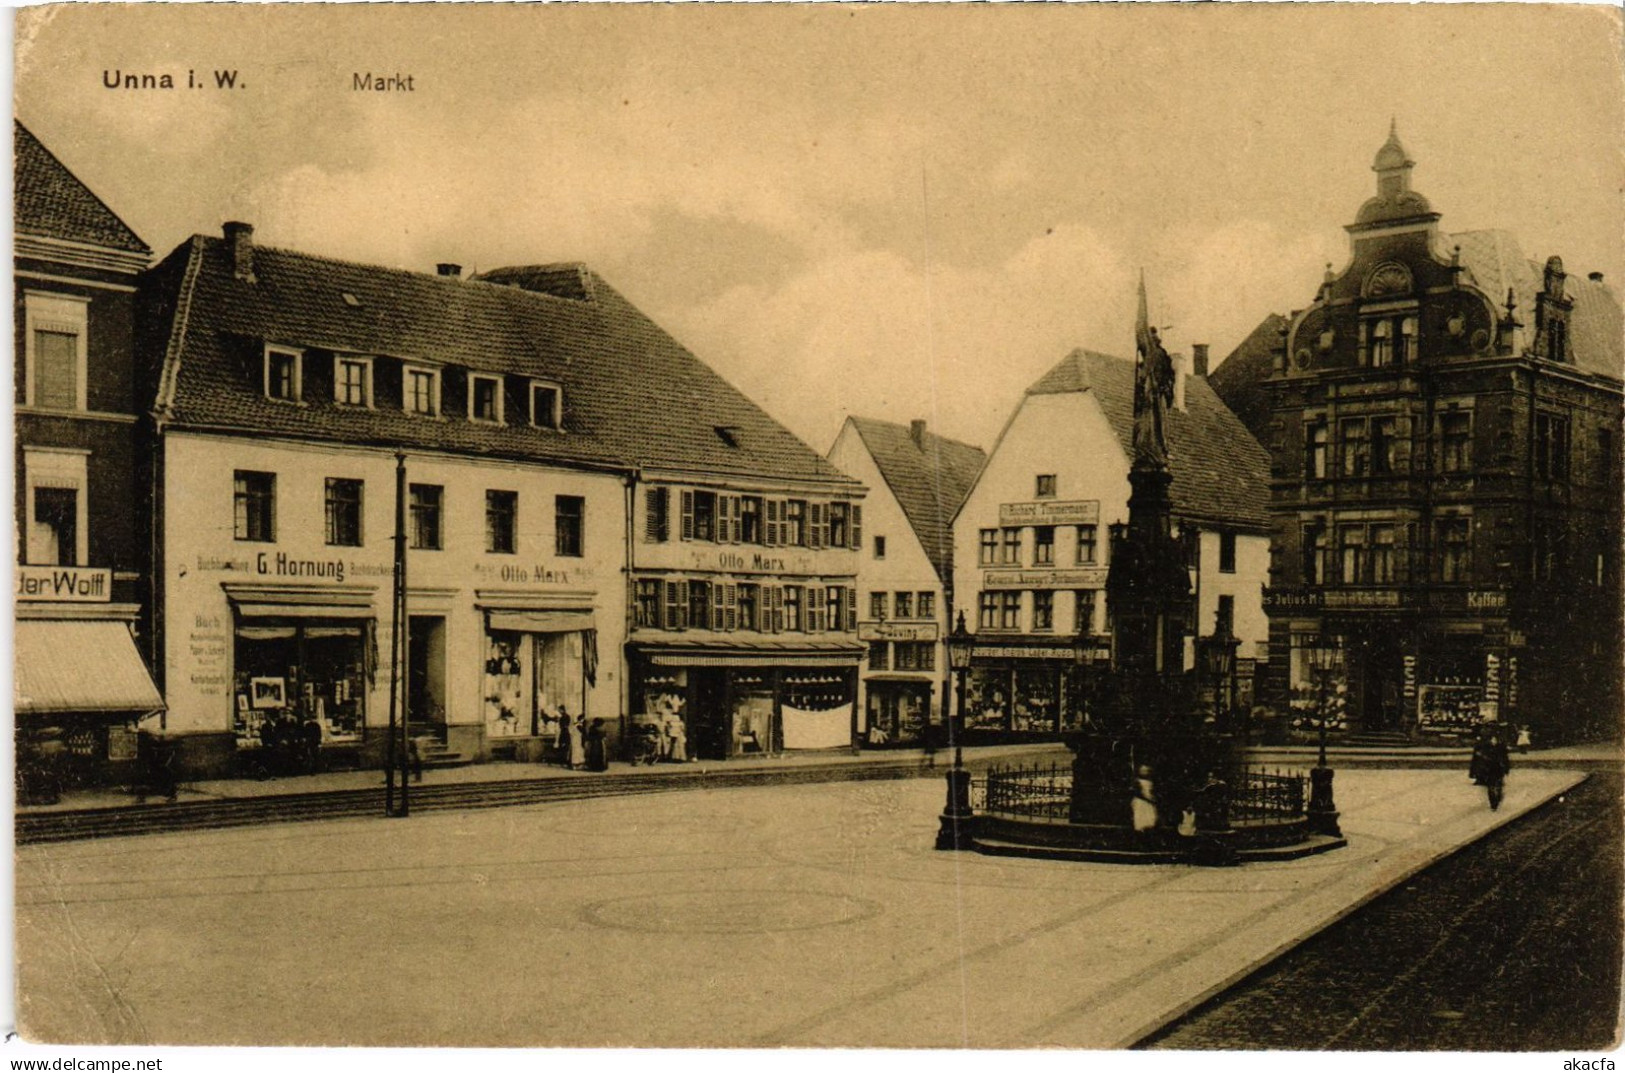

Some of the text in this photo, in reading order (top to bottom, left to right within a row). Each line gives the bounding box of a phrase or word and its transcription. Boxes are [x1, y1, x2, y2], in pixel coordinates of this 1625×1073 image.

[257, 552, 274, 575] G.
[276, 552, 345, 583] Hornung
[719, 552, 745, 569] Otto
[751, 553, 785, 571] Marx
[53, 571, 105, 596] Wolff
[501, 563, 528, 583] Otto
[533, 564, 569, 584] Marx
[1467, 591, 1505, 607] Kaffee
